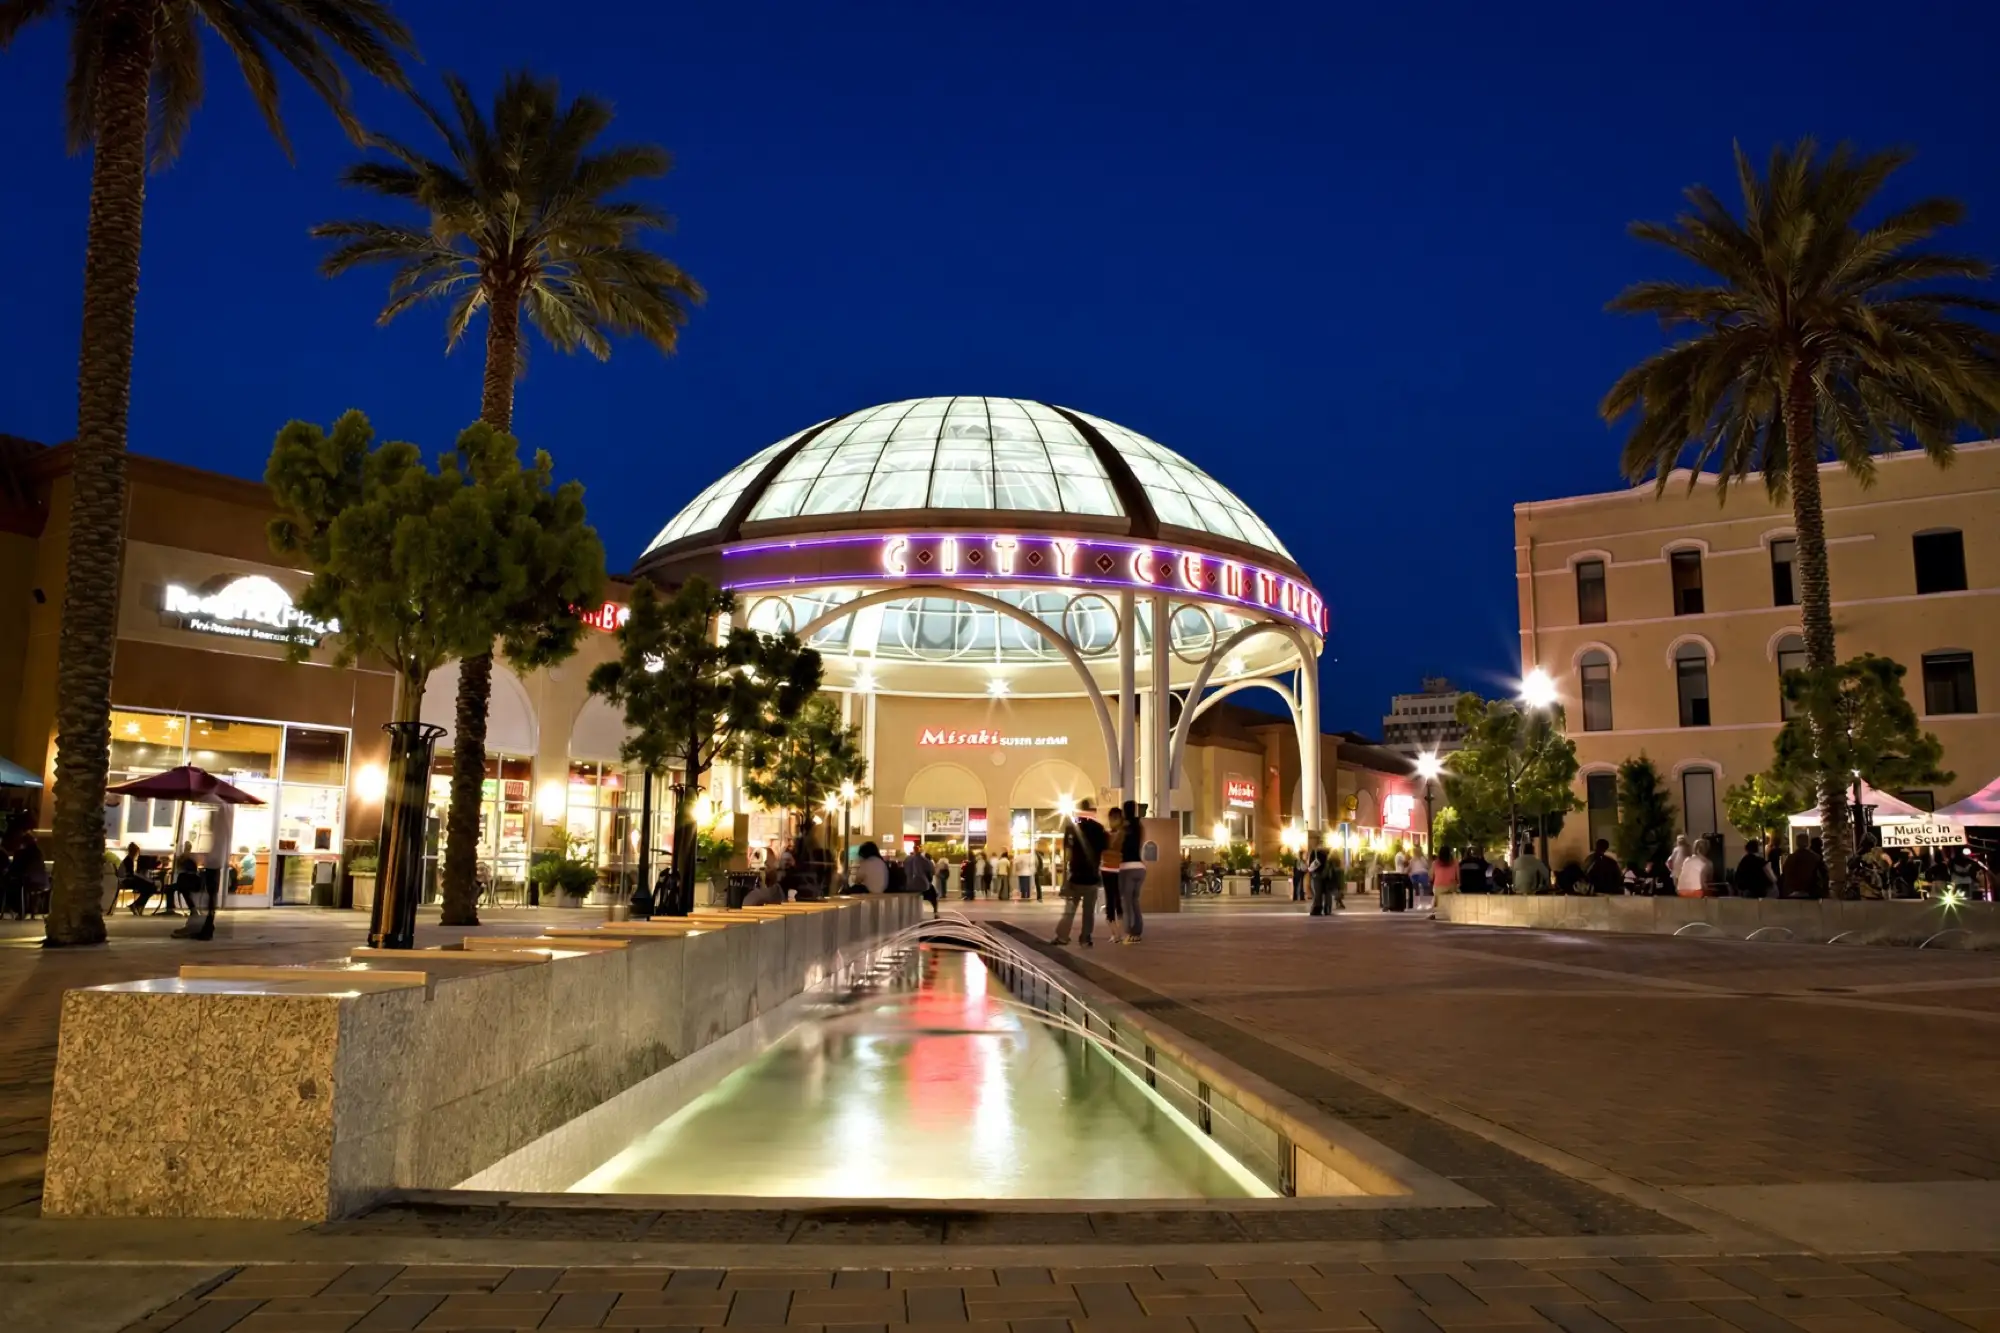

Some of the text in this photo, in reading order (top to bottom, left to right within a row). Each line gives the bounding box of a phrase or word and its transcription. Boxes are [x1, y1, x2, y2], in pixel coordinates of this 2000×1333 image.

[883, 534, 1077, 577] CITY
[920, 728, 999, 745] Misaki
[1894, 825, 1932, 836] Music
[1885, 836, 1911, 846] The
